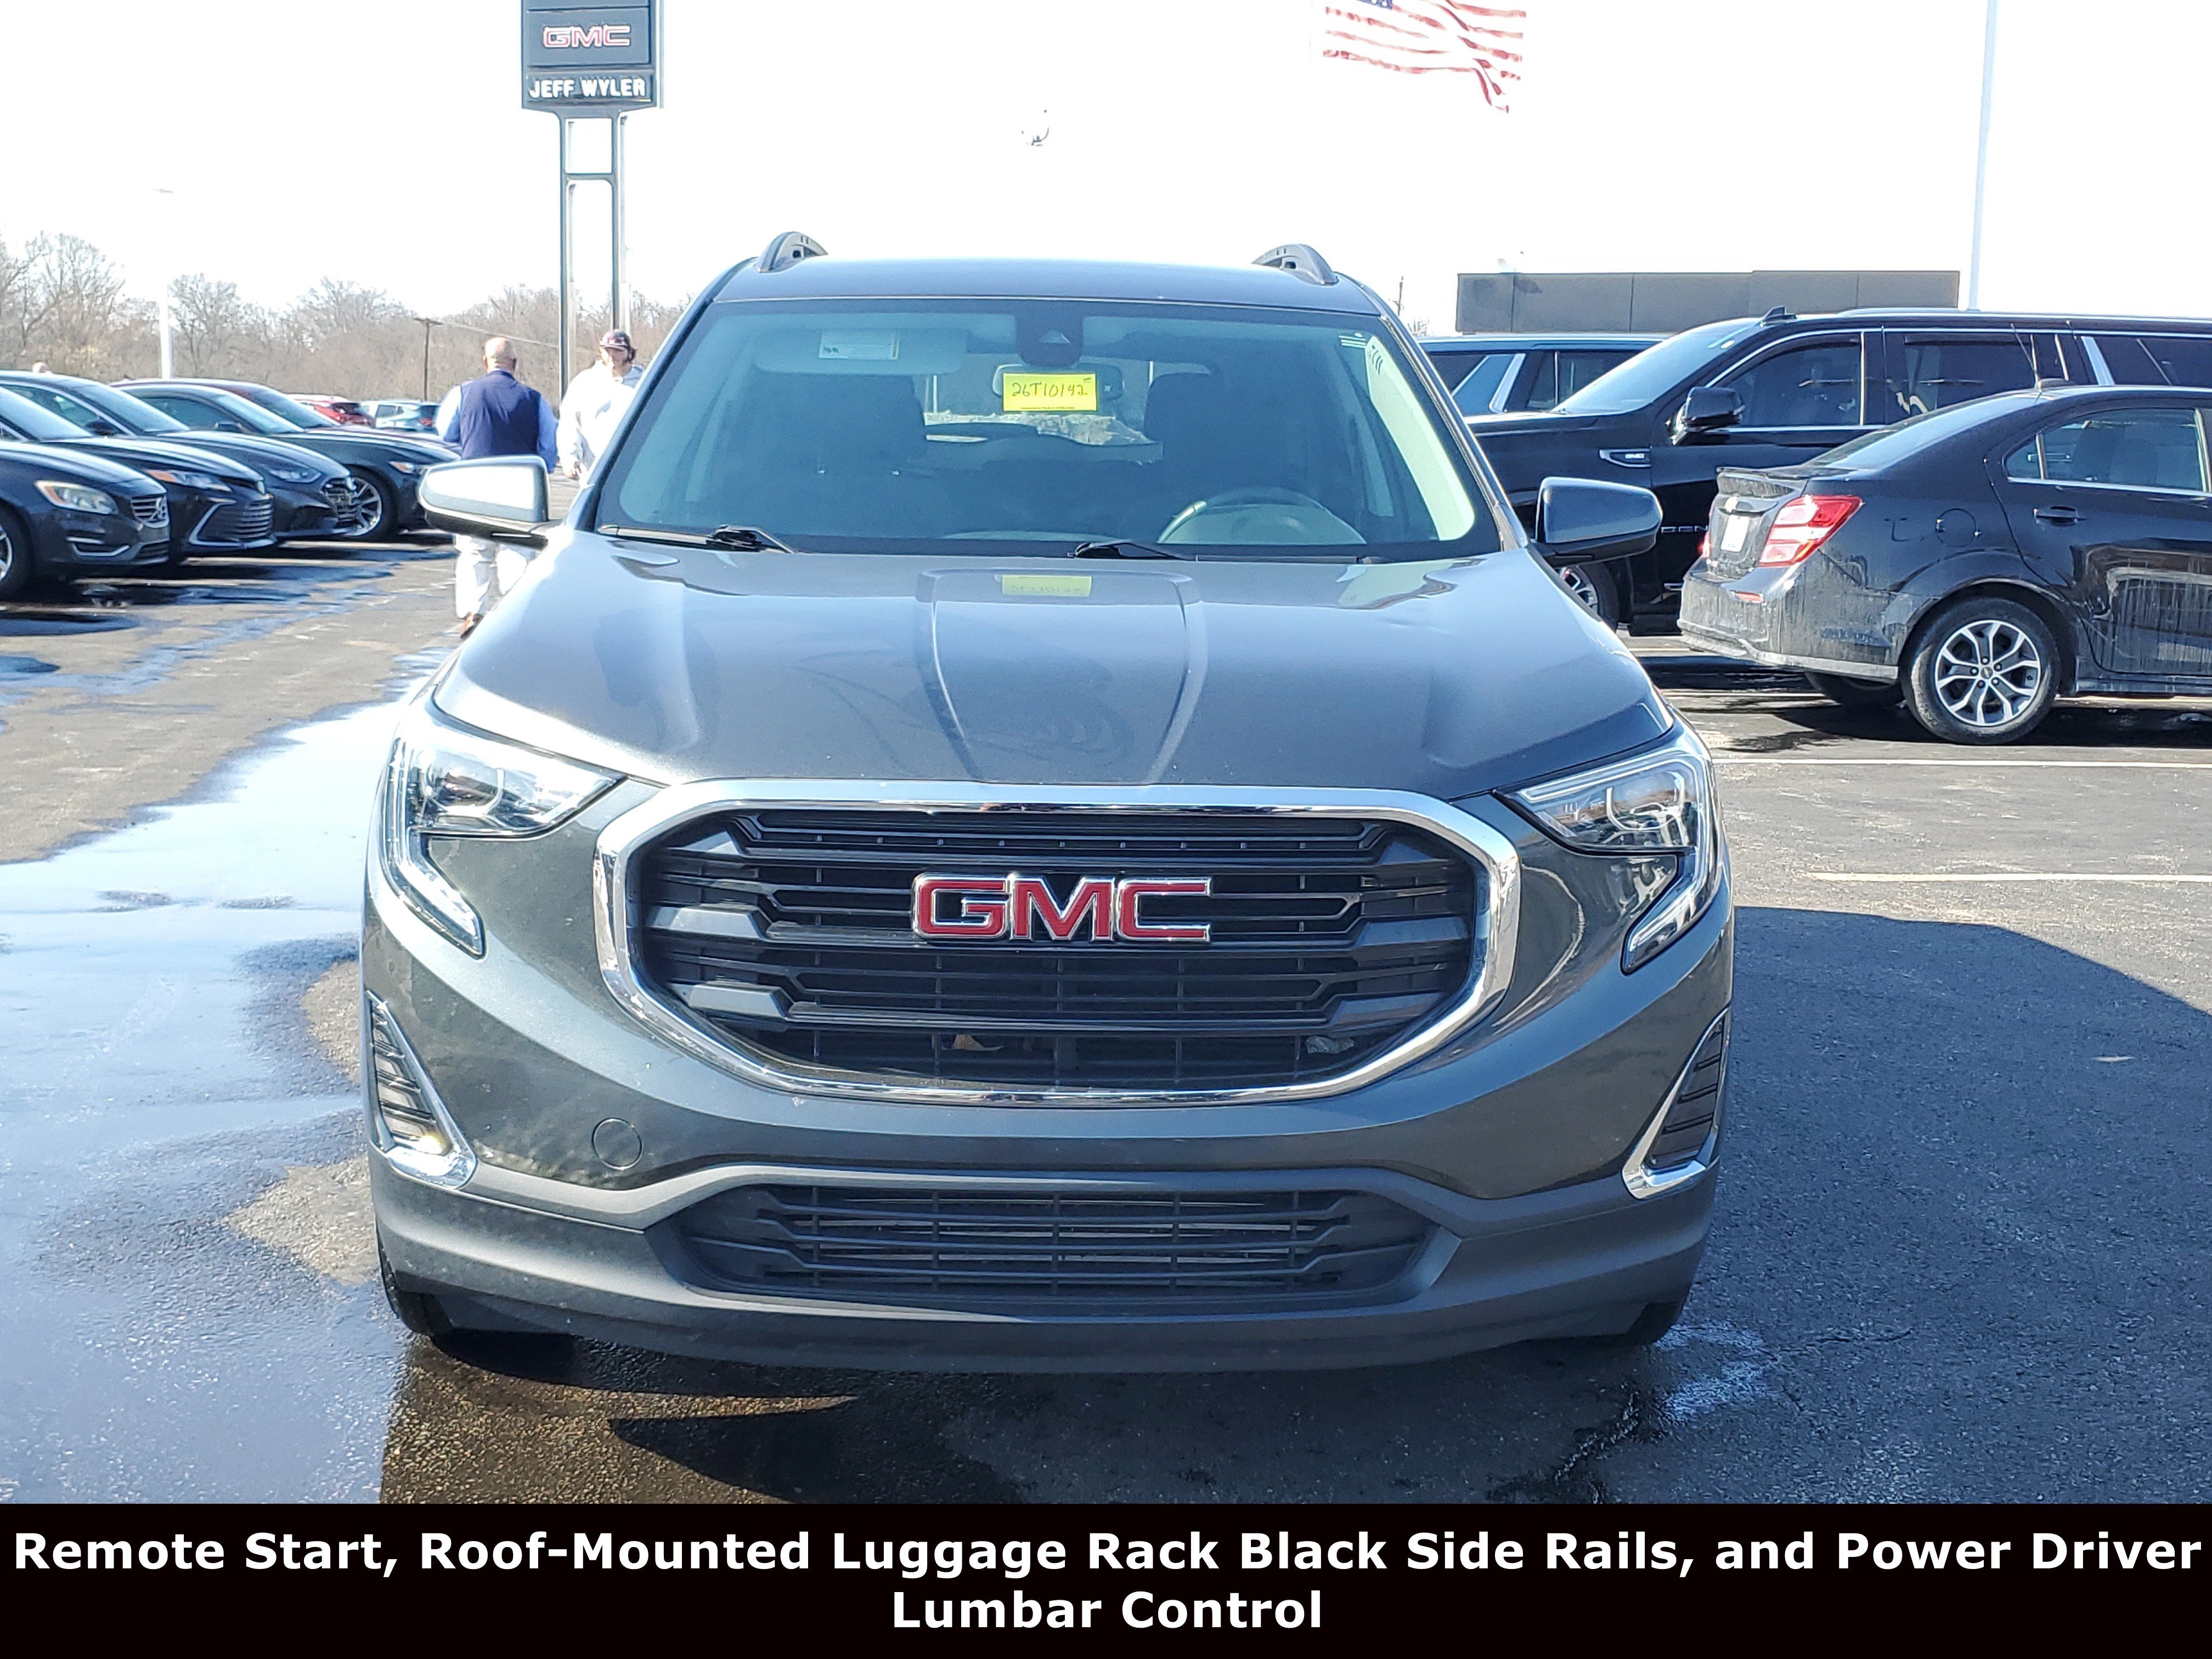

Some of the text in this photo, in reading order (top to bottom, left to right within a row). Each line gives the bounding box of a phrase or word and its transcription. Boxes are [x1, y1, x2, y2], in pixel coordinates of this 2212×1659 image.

[542, 25, 630, 48] GMC
[528, 78, 645, 98] JEFF WYLER
[1661, 526, 1708, 534] DEN
[912, 873, 1211, 941] GMC
